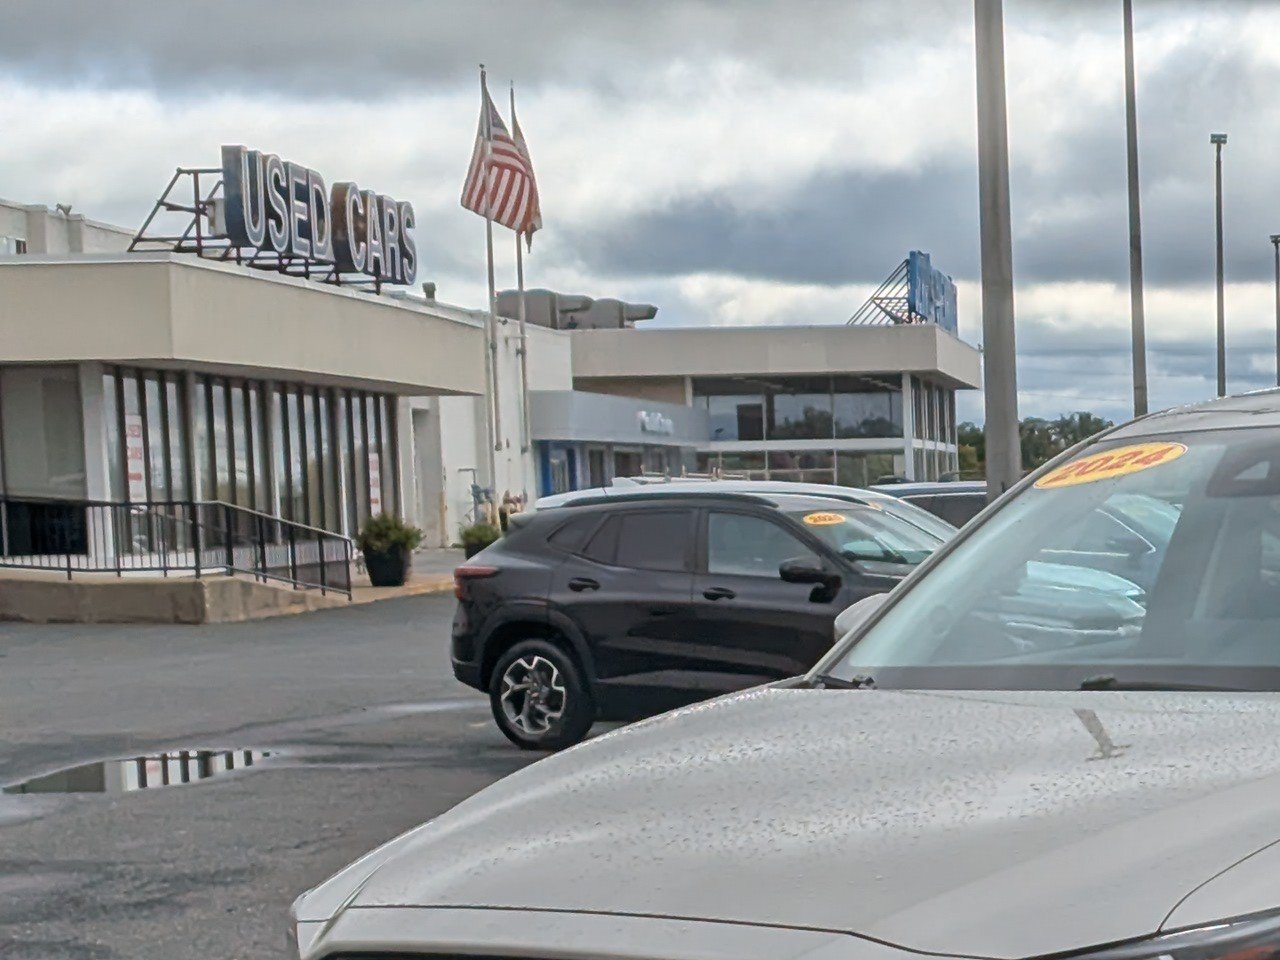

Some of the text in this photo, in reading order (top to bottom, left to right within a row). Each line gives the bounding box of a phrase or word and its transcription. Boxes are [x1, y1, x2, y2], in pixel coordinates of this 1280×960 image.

[231, 148, 418, 286] USED CARS
[1043, 445, 1175, 486] 2024
